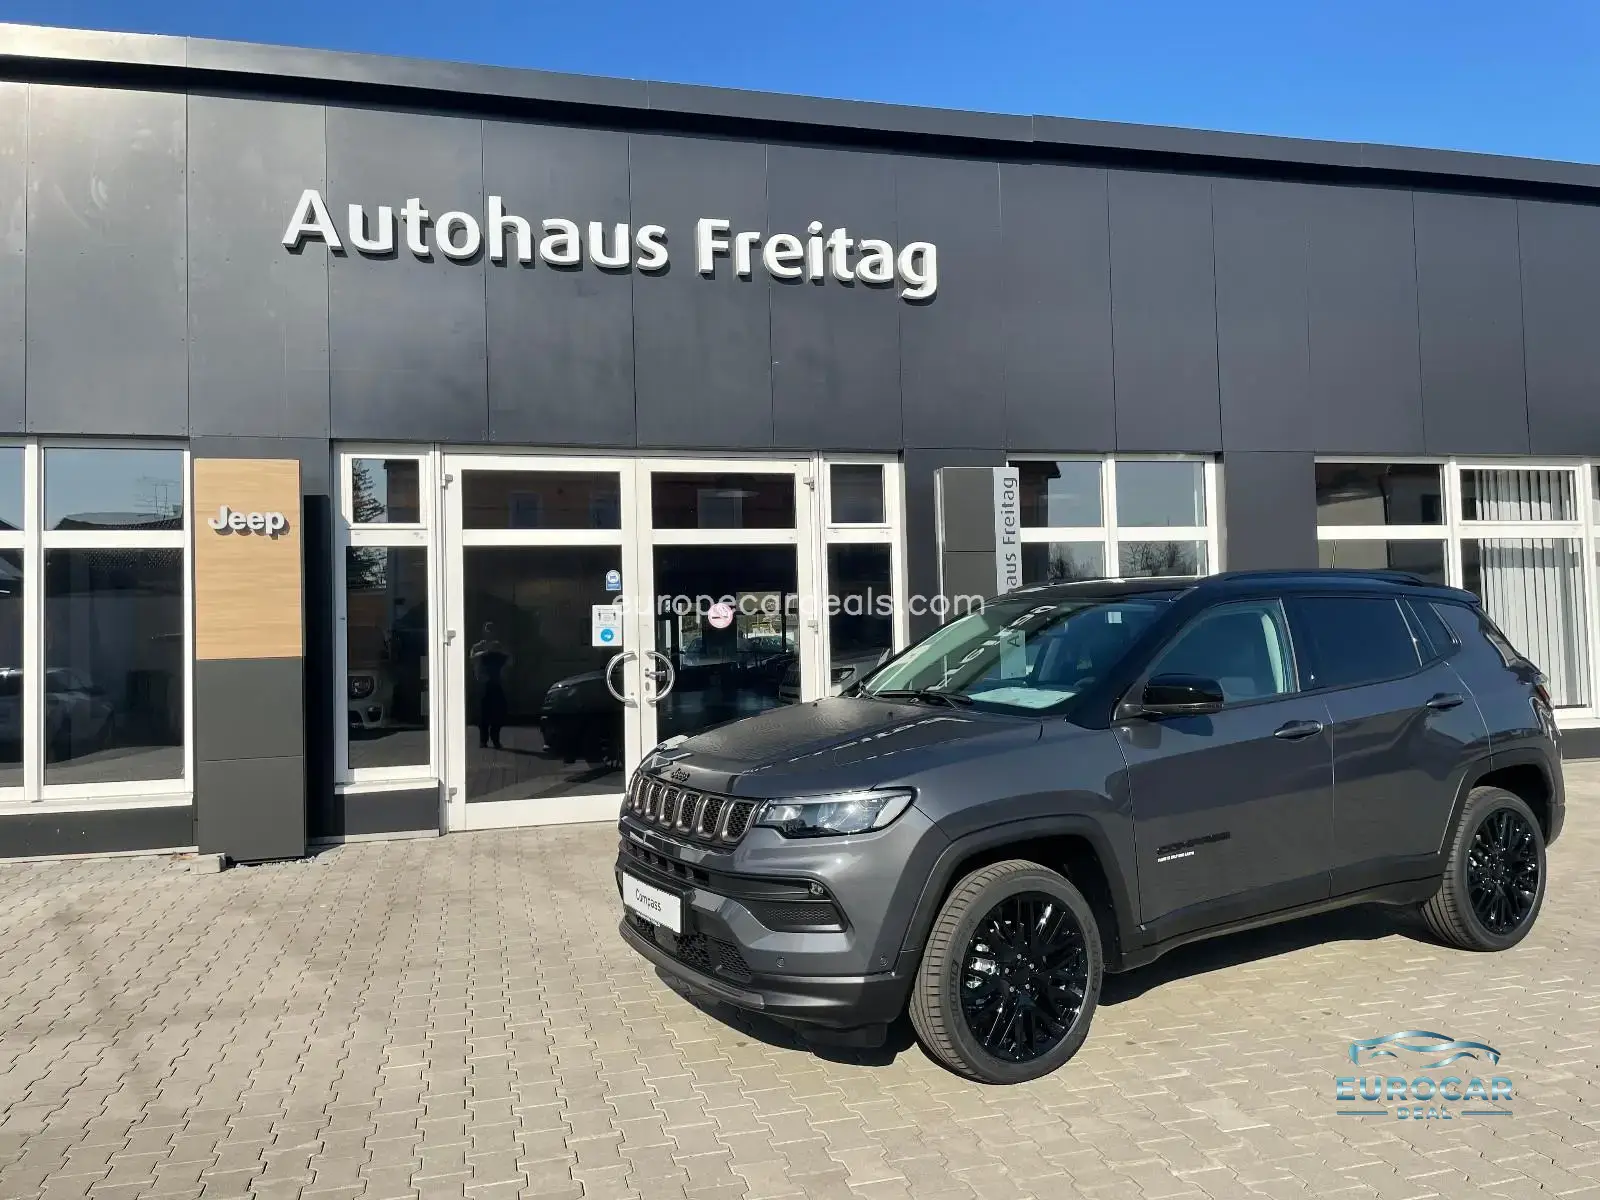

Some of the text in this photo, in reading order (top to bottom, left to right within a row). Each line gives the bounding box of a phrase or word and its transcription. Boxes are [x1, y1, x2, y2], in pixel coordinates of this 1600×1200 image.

[282, 189, 939, 300] Autohaus Freitag
[207, 504, 287, 536] Jeep
[1001, 477, 1018, 586] aus Freitag
[635, 888, 662, 912] Compass
